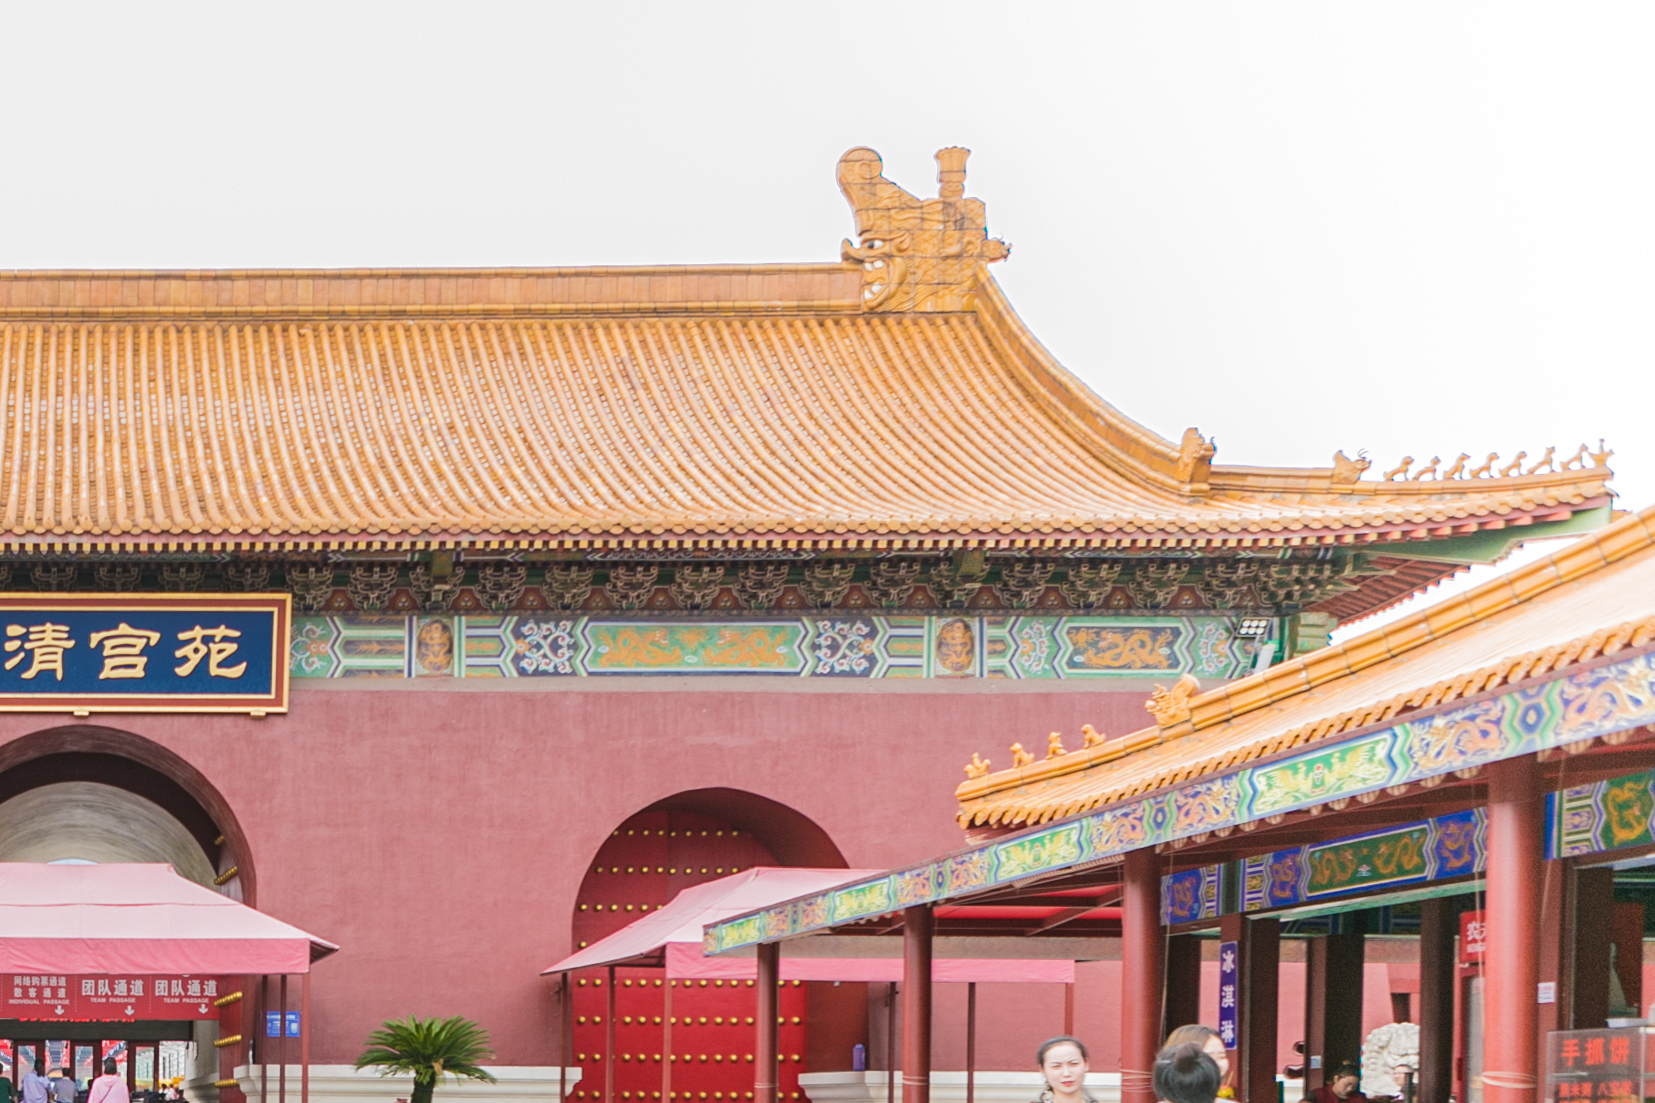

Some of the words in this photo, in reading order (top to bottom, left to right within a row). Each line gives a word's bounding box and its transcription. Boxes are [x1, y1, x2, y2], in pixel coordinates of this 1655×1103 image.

[13, 976, 66, 987] 网络购票通道
[81, 979, 144, 996] 团队通道
[154, 979, 217, 996] 团队通道
[13, 987, 66, 998] 散客通道
[1221, 950, 1235, 1043] 冰淇淋
[1560, 1037, 1630, 1067] 手抓饼
